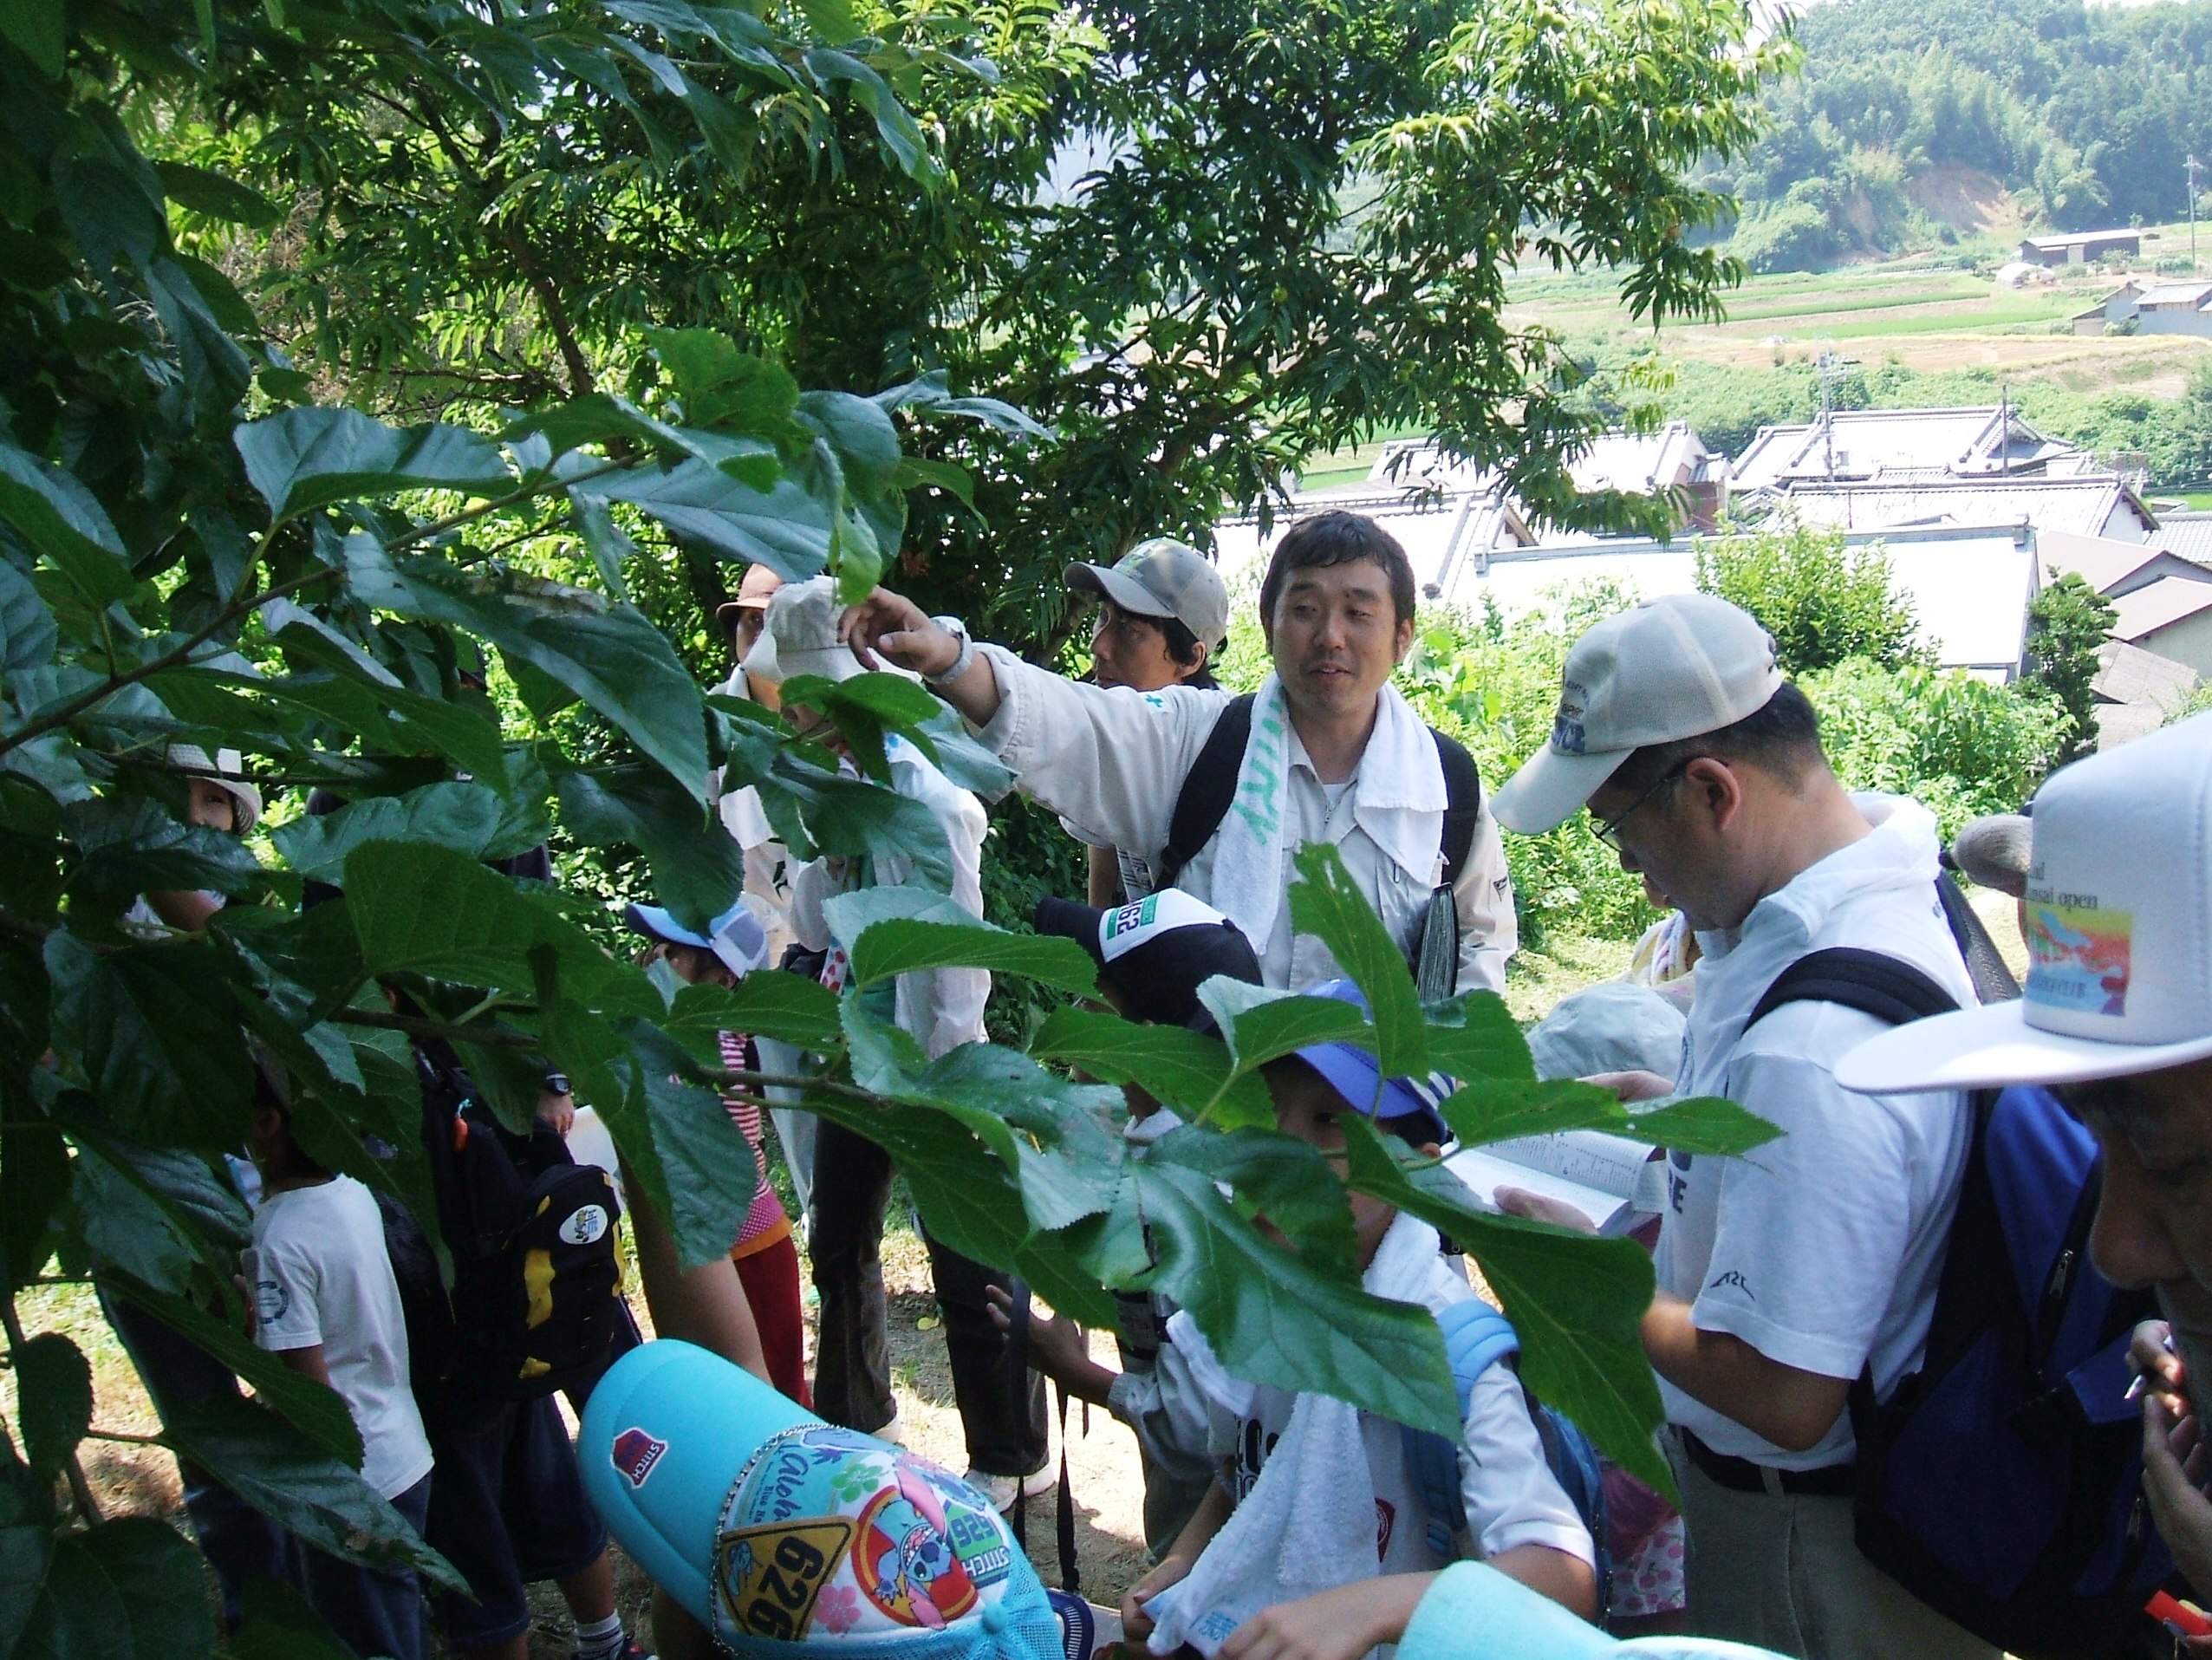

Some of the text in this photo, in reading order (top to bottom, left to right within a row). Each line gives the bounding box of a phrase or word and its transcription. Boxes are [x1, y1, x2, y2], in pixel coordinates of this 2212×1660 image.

[2059, 893, 2098, 912] open
[632, 1442, 660, 1479] STITCH
[950, 1513, 995, 1548] 626
[961, 1546, 1010, 1577] STITCH
[747, 1535, 825, 1642] 626
